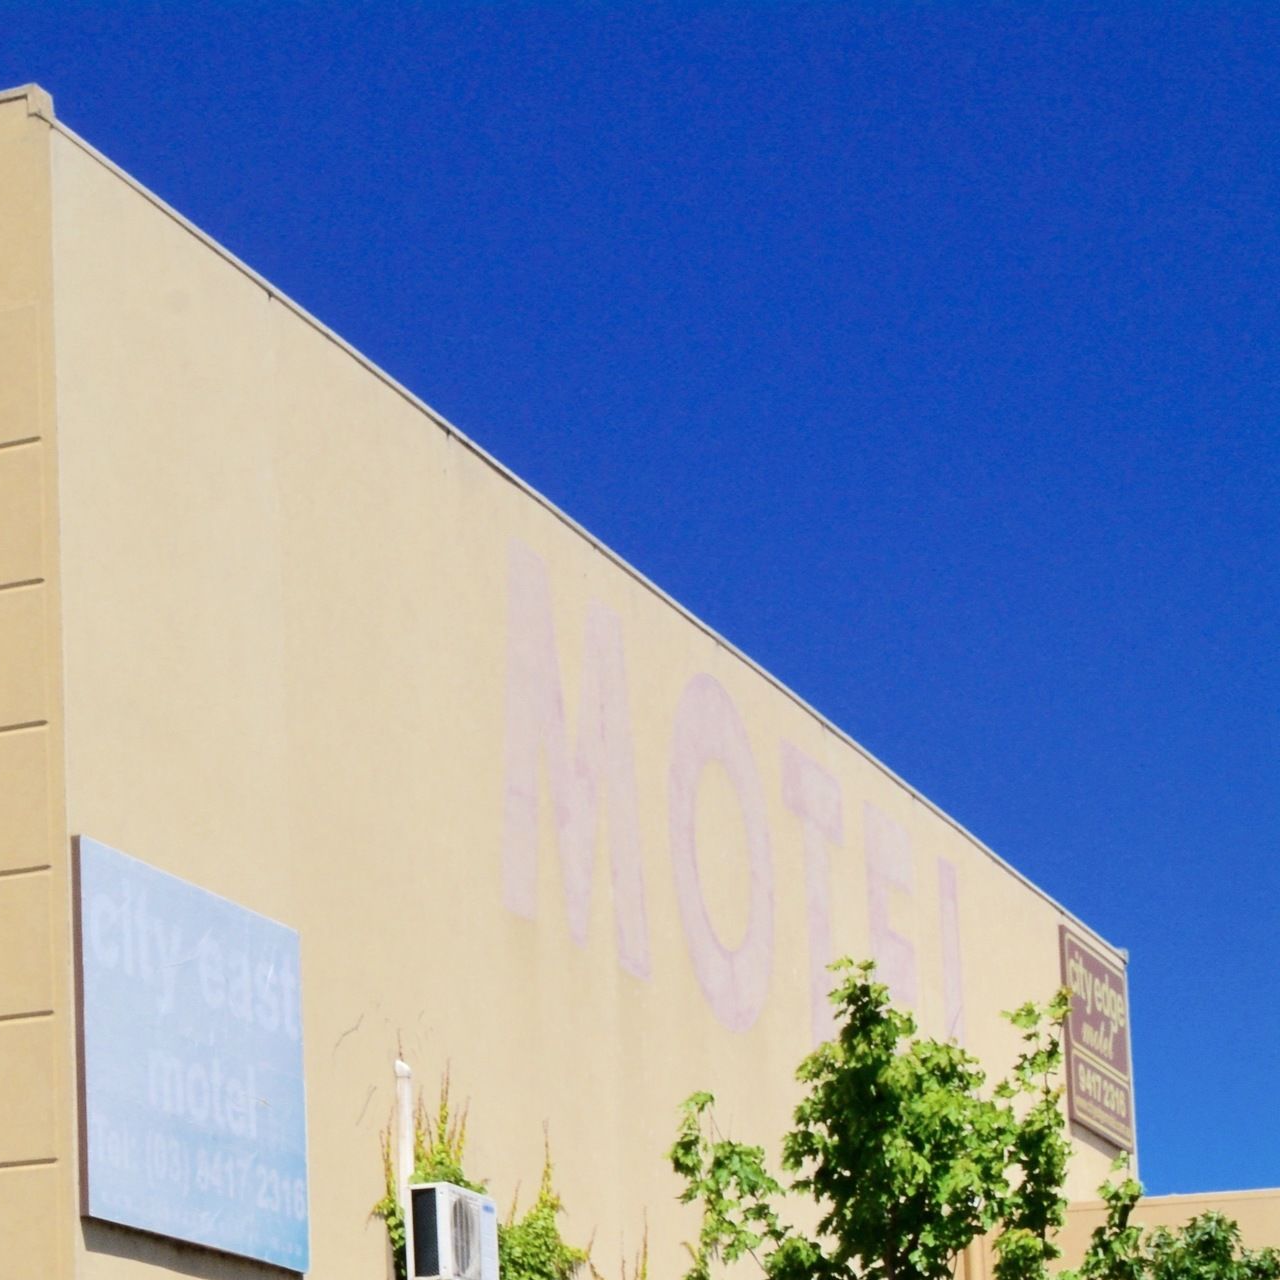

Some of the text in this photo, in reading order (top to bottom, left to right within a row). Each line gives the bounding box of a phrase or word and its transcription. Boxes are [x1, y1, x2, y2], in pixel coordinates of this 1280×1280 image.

[93, 880, 298, 1041] city east
[1069, 953, 1125, 1034] city edge
[148, 1048, 258, 1139] motel
